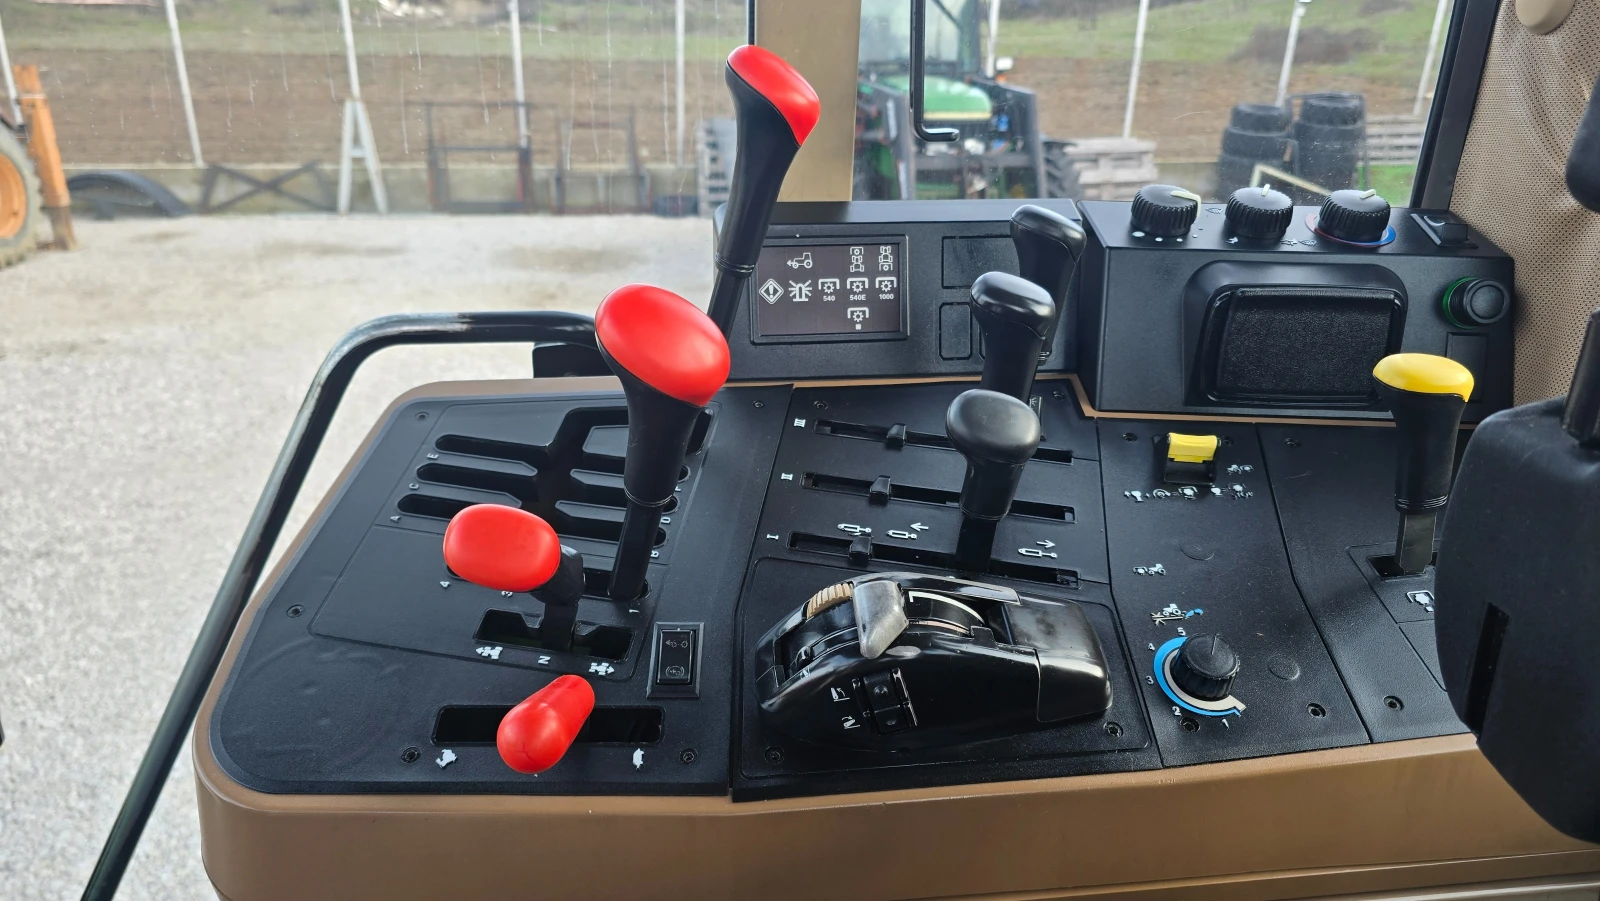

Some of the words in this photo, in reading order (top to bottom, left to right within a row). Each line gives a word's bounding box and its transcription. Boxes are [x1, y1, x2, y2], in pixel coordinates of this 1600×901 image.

[426, 452, 439, 460] E
[408, 482, 420, 490] C
[389, 515, 402, 523] A
[660, 516, 671, 525] D
[650, 550, 660, 558] B
[439, 580, 452, 589] 4
[1176, 626, 1187, 637] 5
[1147, 642, 1156, 651] 4
[537, 655, 551, 665] N
[1145, 675, 1154, 685] 3
[1171, 705, 1182, 717] 2
[1221, 718, 1230, 729] 1
